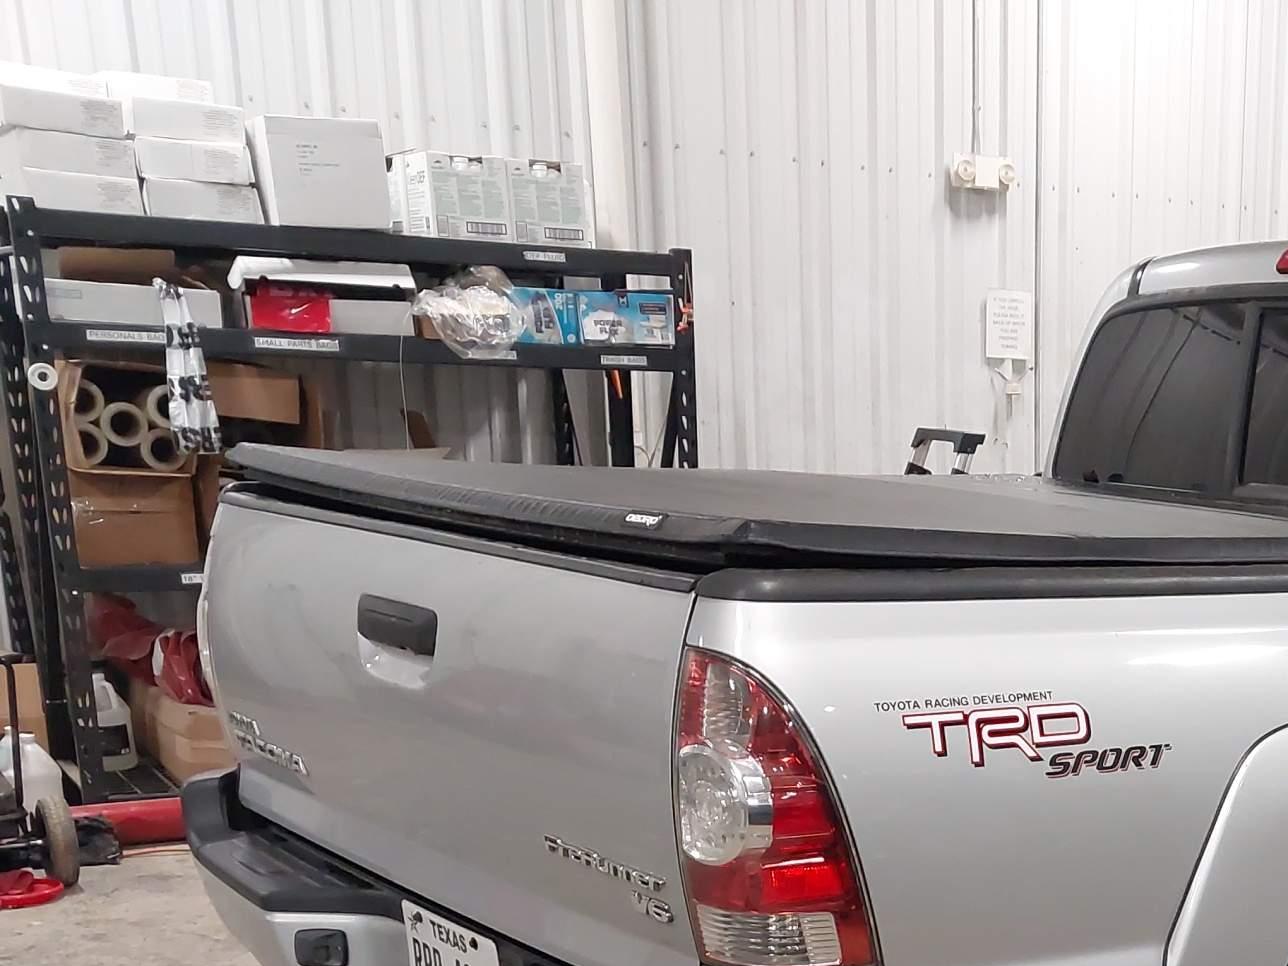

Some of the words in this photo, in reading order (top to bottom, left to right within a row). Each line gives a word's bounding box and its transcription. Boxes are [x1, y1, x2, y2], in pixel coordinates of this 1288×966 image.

[88, 330, 143, 340] PERSONALS
[256, 338, 283, 347] SMALL
[874, 701, 921, 713] TOYOTA
[924, 696, 970, 709] RACING
[972, 691, 1054, 706] DEVELOPMENT
[901, 702, 1092, 768] TRD
[1045, 743, 1172, 779] SPORT
[428, 919, 468, 954] TEXAS
